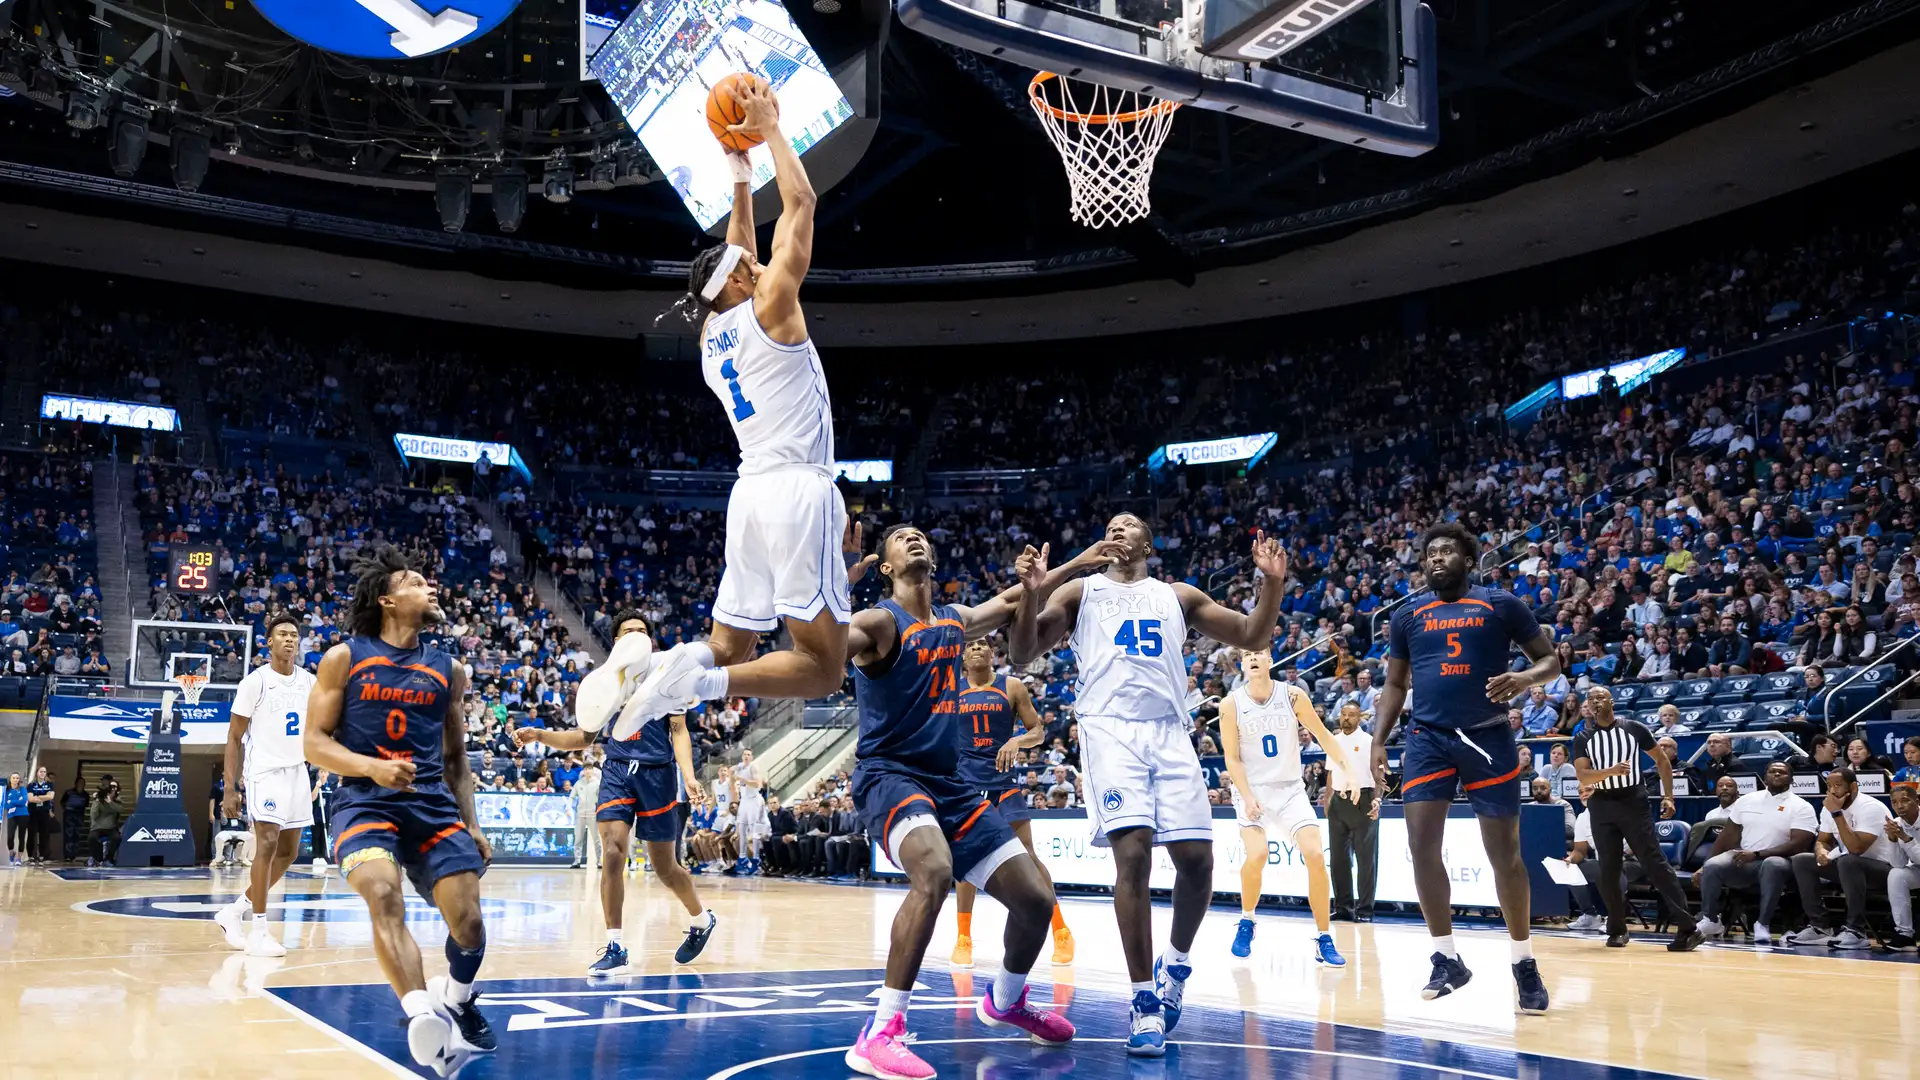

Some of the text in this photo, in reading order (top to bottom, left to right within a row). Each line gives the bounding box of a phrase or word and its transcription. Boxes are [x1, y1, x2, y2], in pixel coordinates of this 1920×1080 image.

[720, 358, 756, 423] 1
[400, 438, 469, 458] GO COUGS
[1171, 443, 1238, 463] GO COUGS
[189, 552, 213, 566] 1:03
[178, 565, 208, 589] 25
[1097, 593, 1170, 622] BYU
[1424, 616, 1485, 632] MORGAN
[1114, 619, 1163, 657] 45
[1446, 632, 1462, 658] 5
[1440, 662, 1471, 676] STATE
[360, 683, 437, 705] MORGAN
[958, 702, 1003, 714] MORGAN
[286, 711, 300, 736] 2
[386, 708, 407, 741] 0
[972, 714, 991, 734] 11
[1244, 714, 1290, 736] BYU
[973, 736, 993, 747] STATE
[1262, 734, 1278, 758] 0
